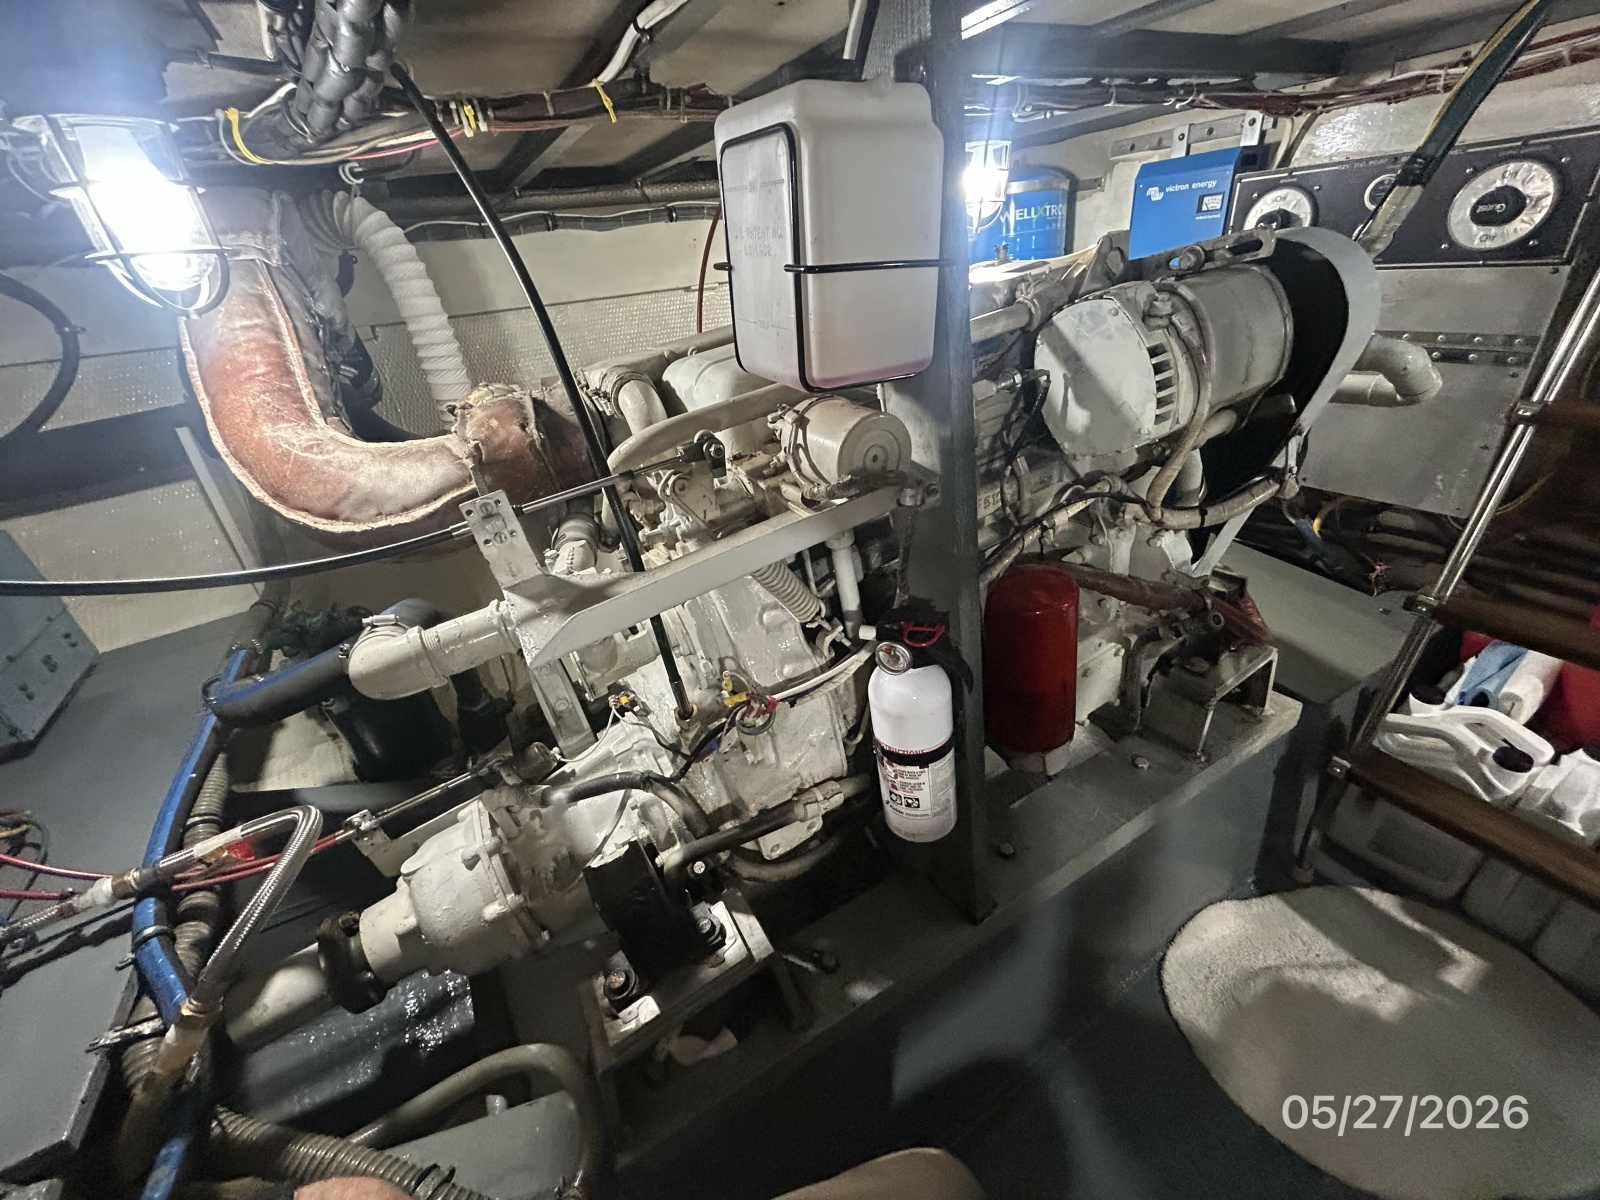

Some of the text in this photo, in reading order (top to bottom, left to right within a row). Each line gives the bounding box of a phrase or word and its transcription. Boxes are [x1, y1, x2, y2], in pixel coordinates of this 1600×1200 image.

[1502, 169, 1518, 180] On
[1165, 180, 1218, 192] victron energy
[1275, 195, 1287, 203] On
